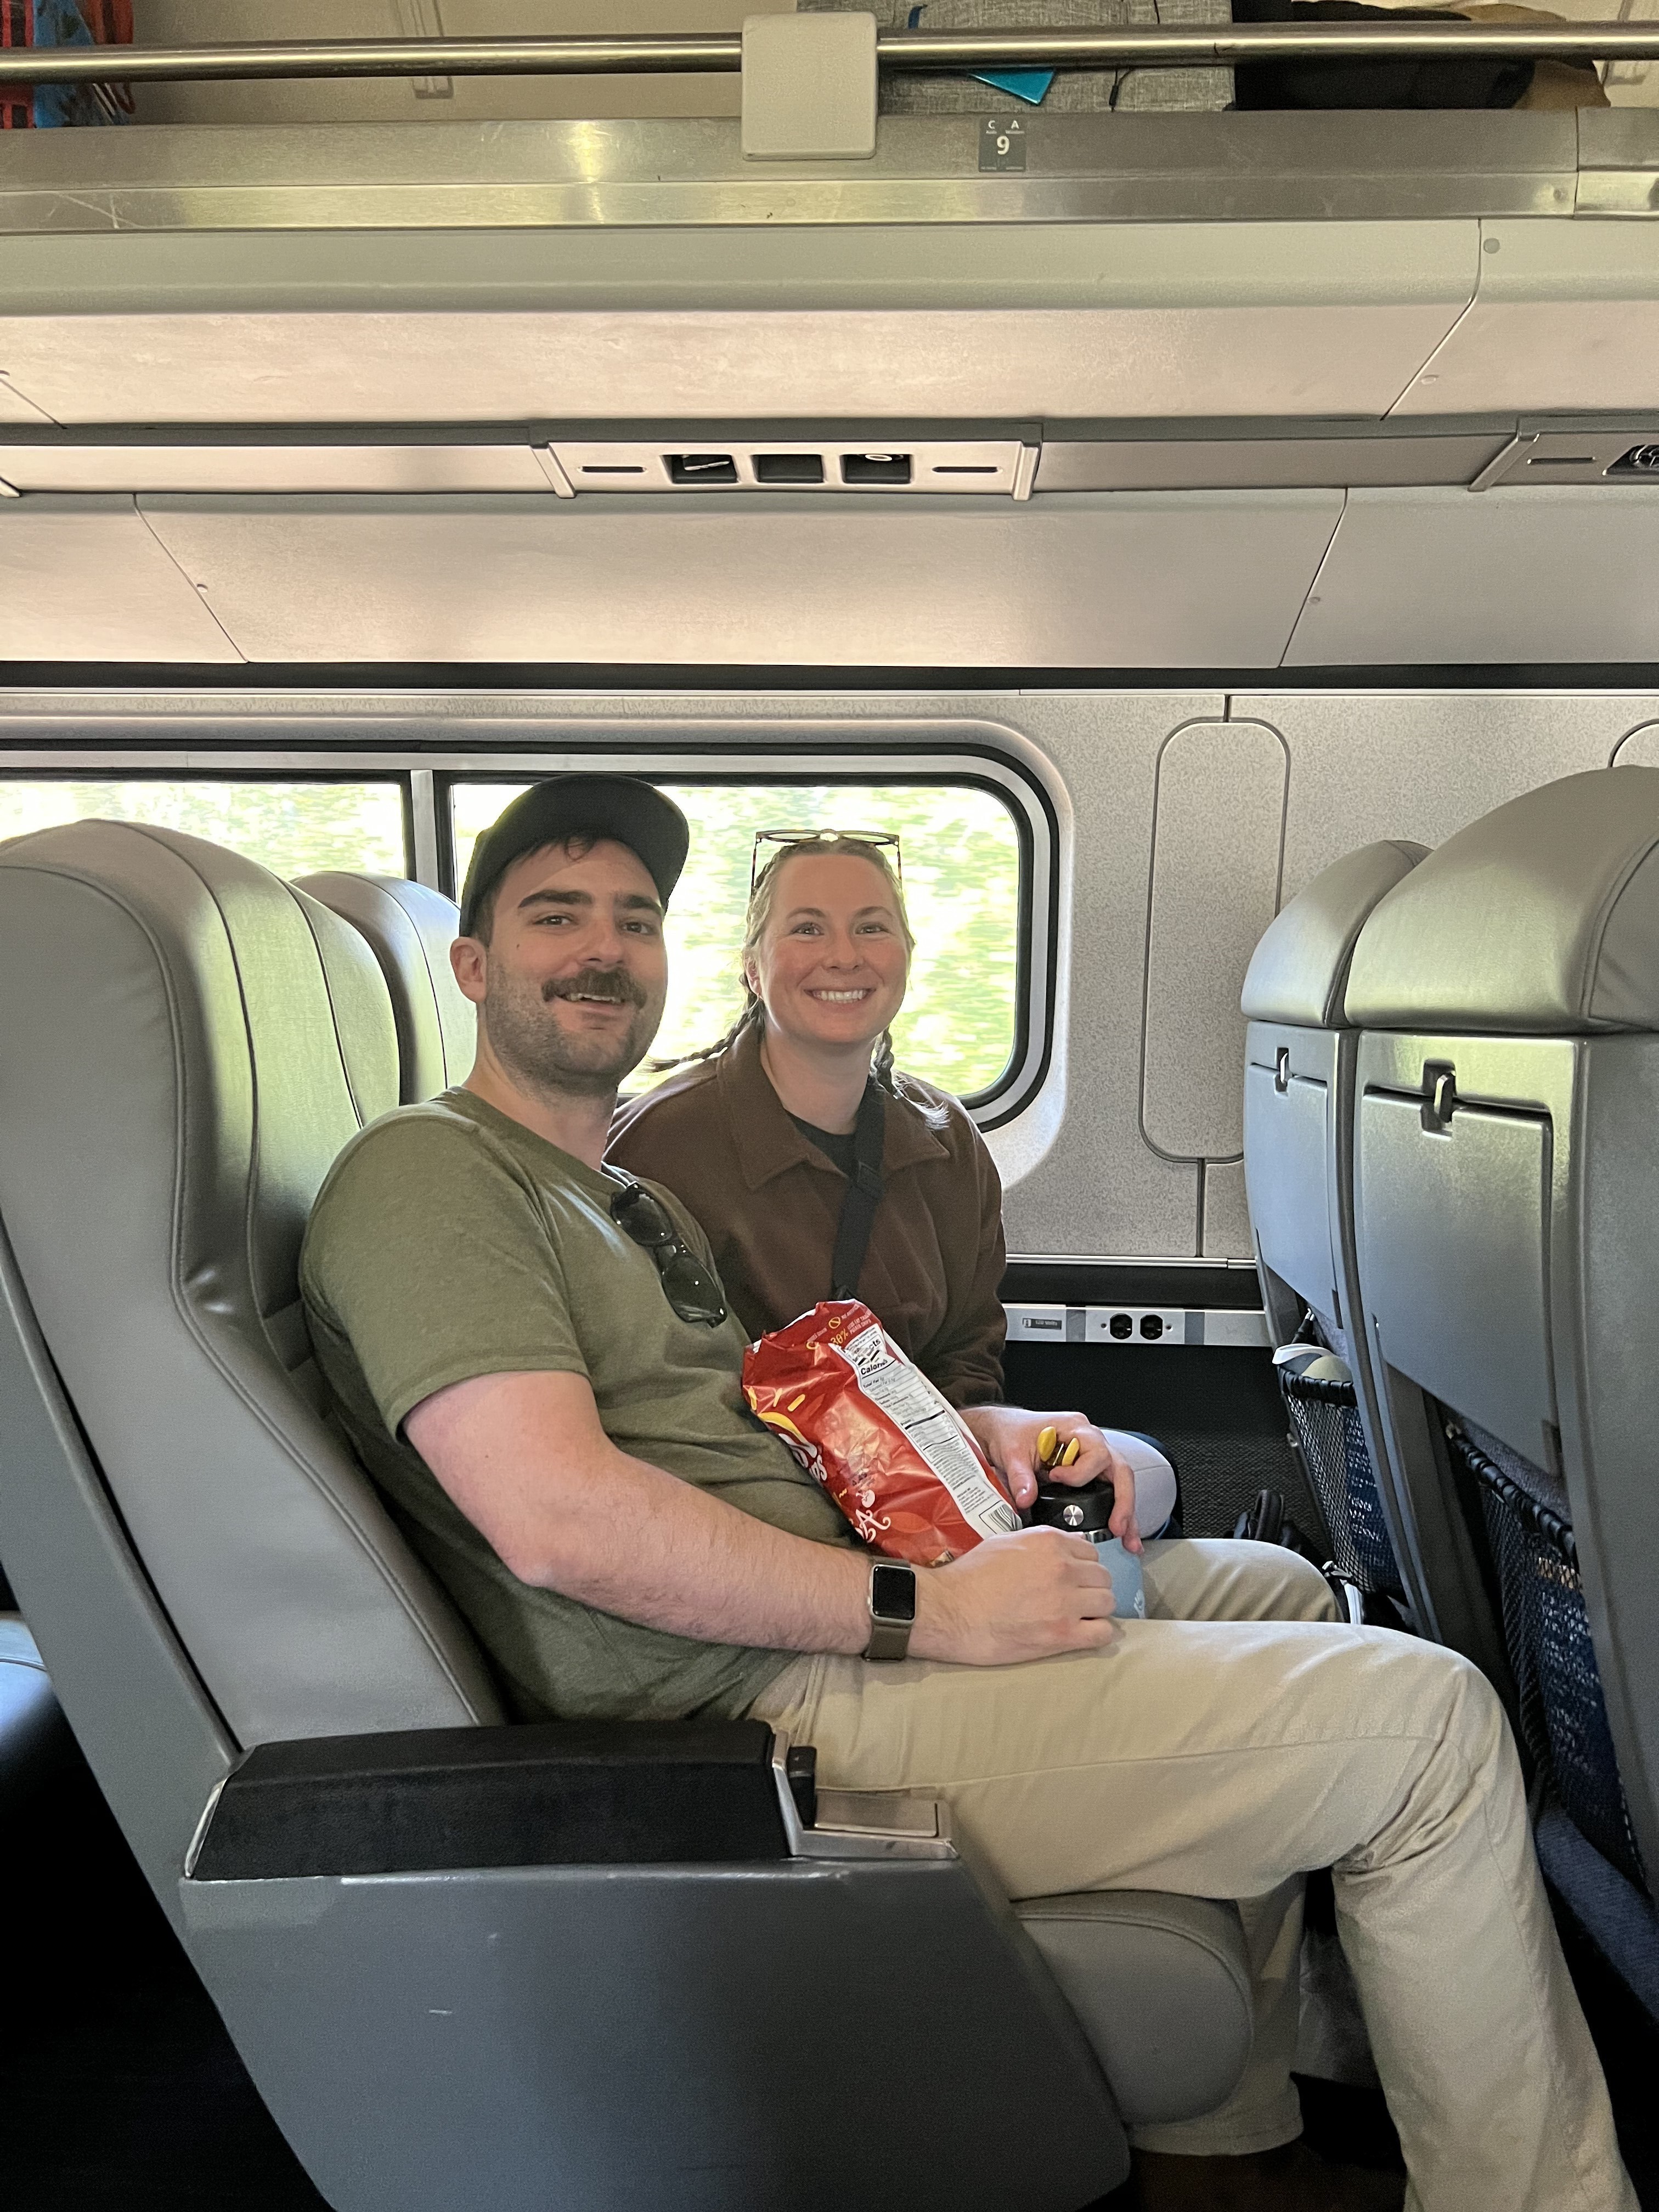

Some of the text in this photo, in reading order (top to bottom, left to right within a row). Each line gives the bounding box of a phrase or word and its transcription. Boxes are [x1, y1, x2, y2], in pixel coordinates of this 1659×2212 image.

[988, 120, 1019, 129] C A
[997, 136, 1010, 155] 9
